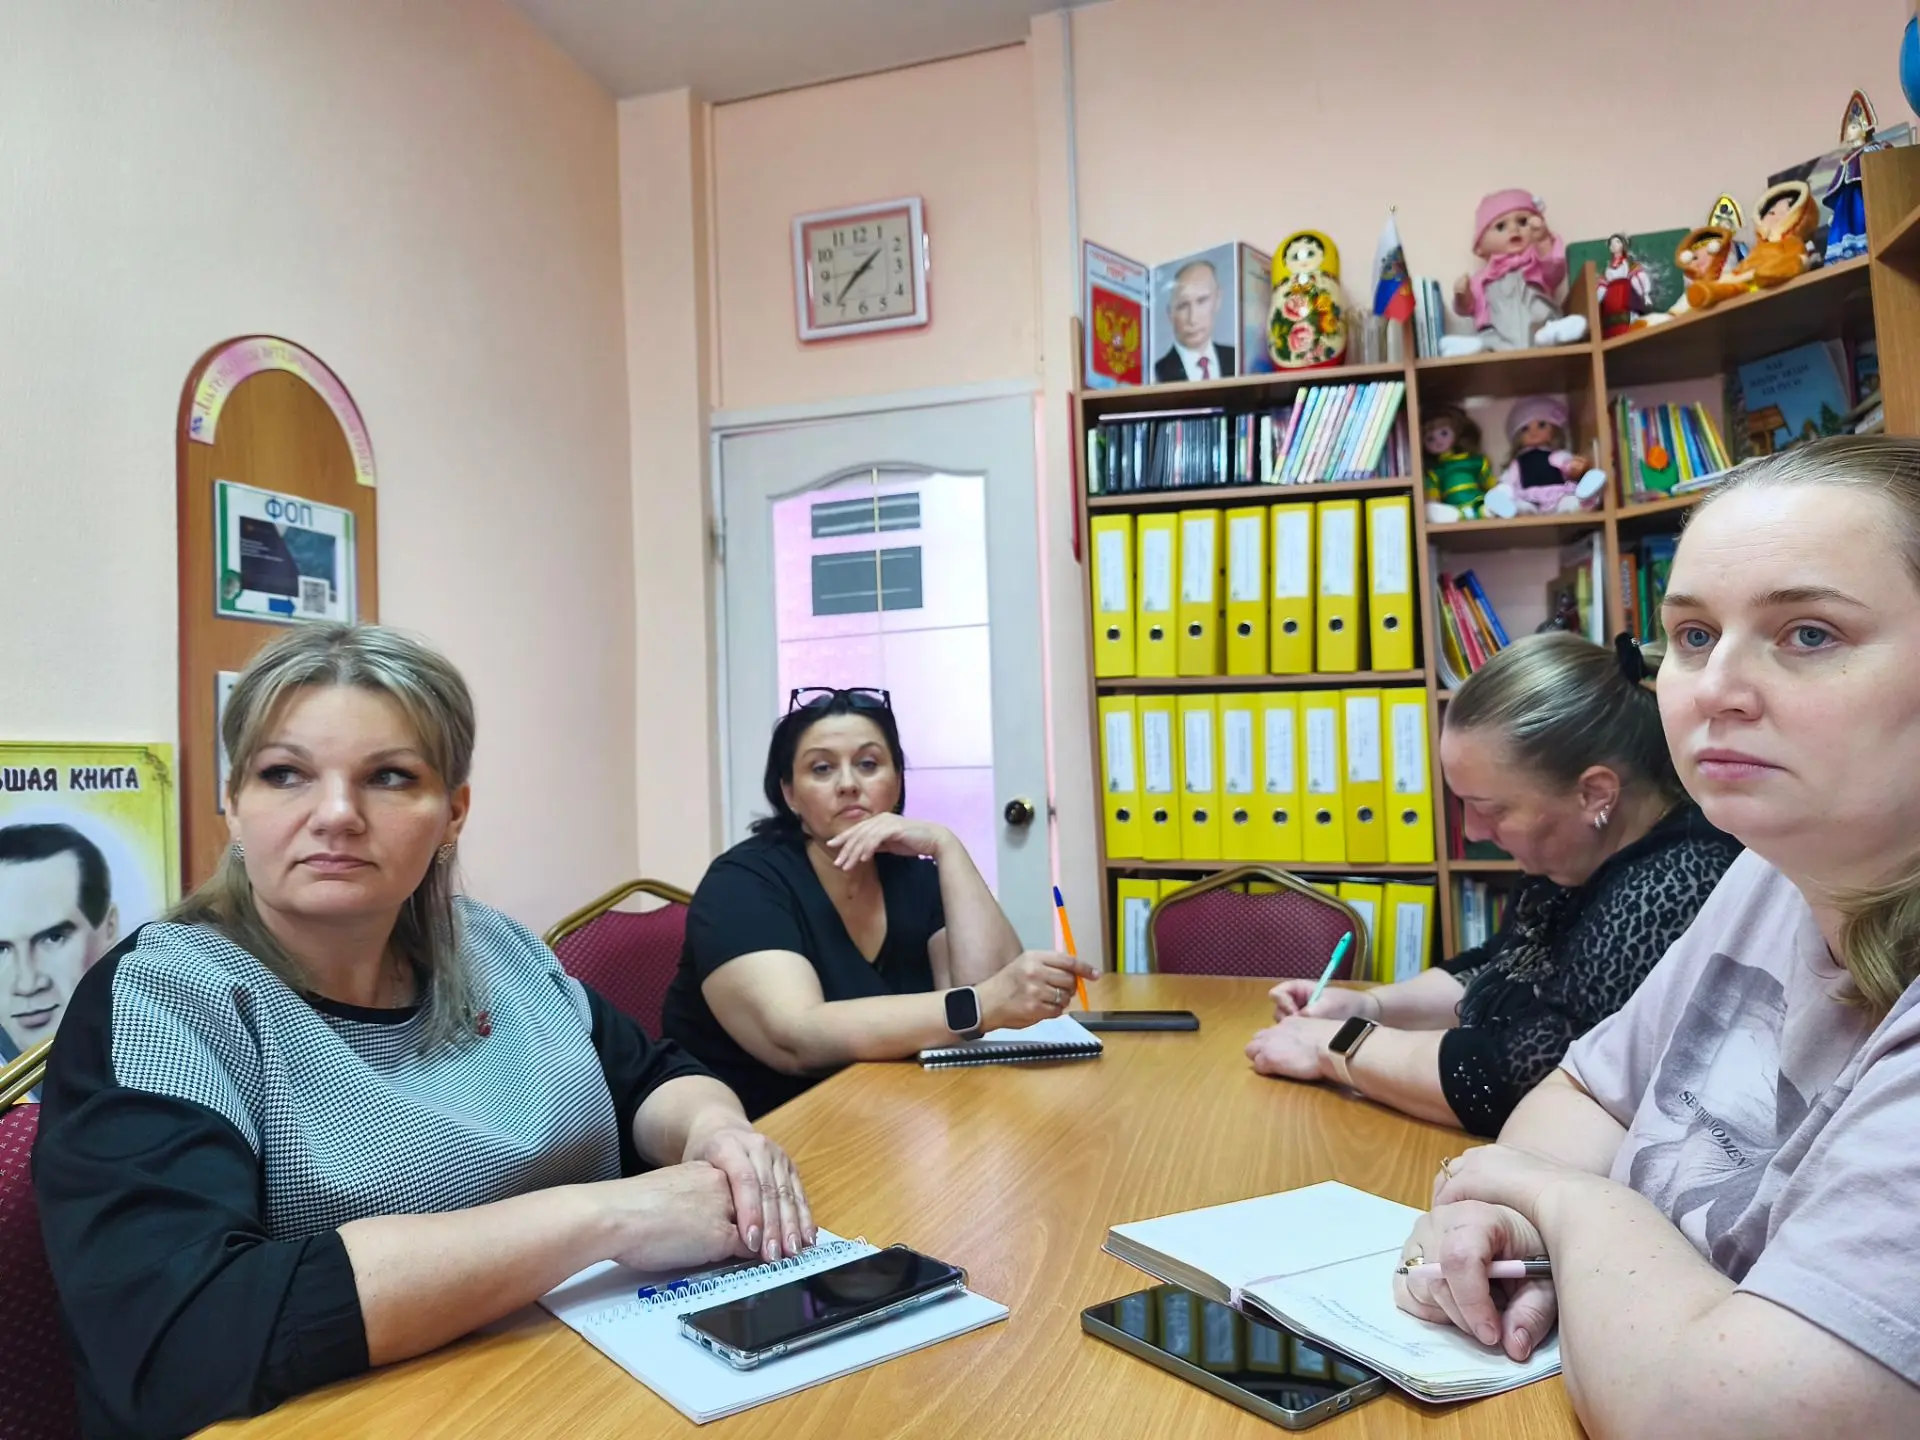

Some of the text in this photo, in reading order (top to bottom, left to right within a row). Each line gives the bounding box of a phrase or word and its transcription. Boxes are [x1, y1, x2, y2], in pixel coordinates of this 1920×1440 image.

[833, 231, 845, 247] 11
[852, 226, 867, 243] 12
[877, 225, 883, 240] 1
[893, 236, 902, 252] 2
[817, 248, 833, 263] 10
[893, 257, 903, 274] 3
[820, 270, 831, 284] 9
[894, 282, 904, 296] 4
[858, 301, 869, 316] 6
[879, 297, 888, 312] 5
[264, 496, 313, 527] ФОП
